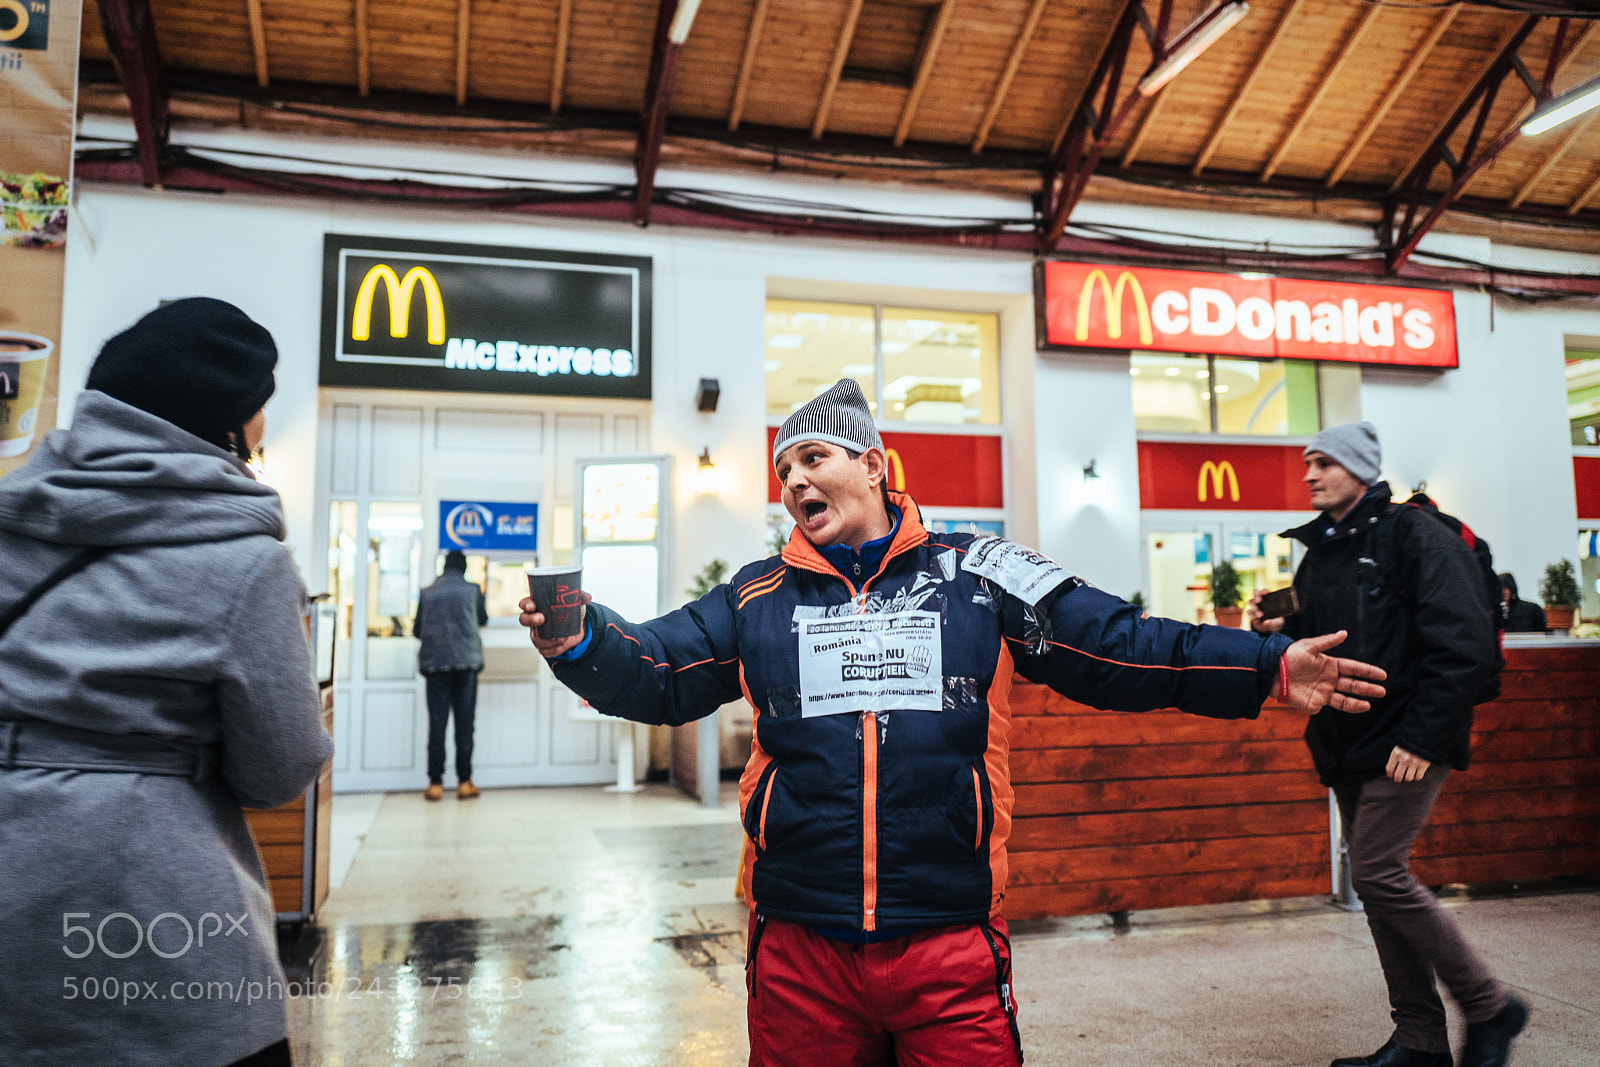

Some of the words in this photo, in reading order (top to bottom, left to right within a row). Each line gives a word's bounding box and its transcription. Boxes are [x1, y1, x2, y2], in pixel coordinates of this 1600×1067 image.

[1075, 269, 1435, 350] McDonald's
[445, 338, 633, 378] McExpress
[813, 635, 862, 653] România
[842, 651, 883, 663] Spune
[886, 648, 905, 659] NU
